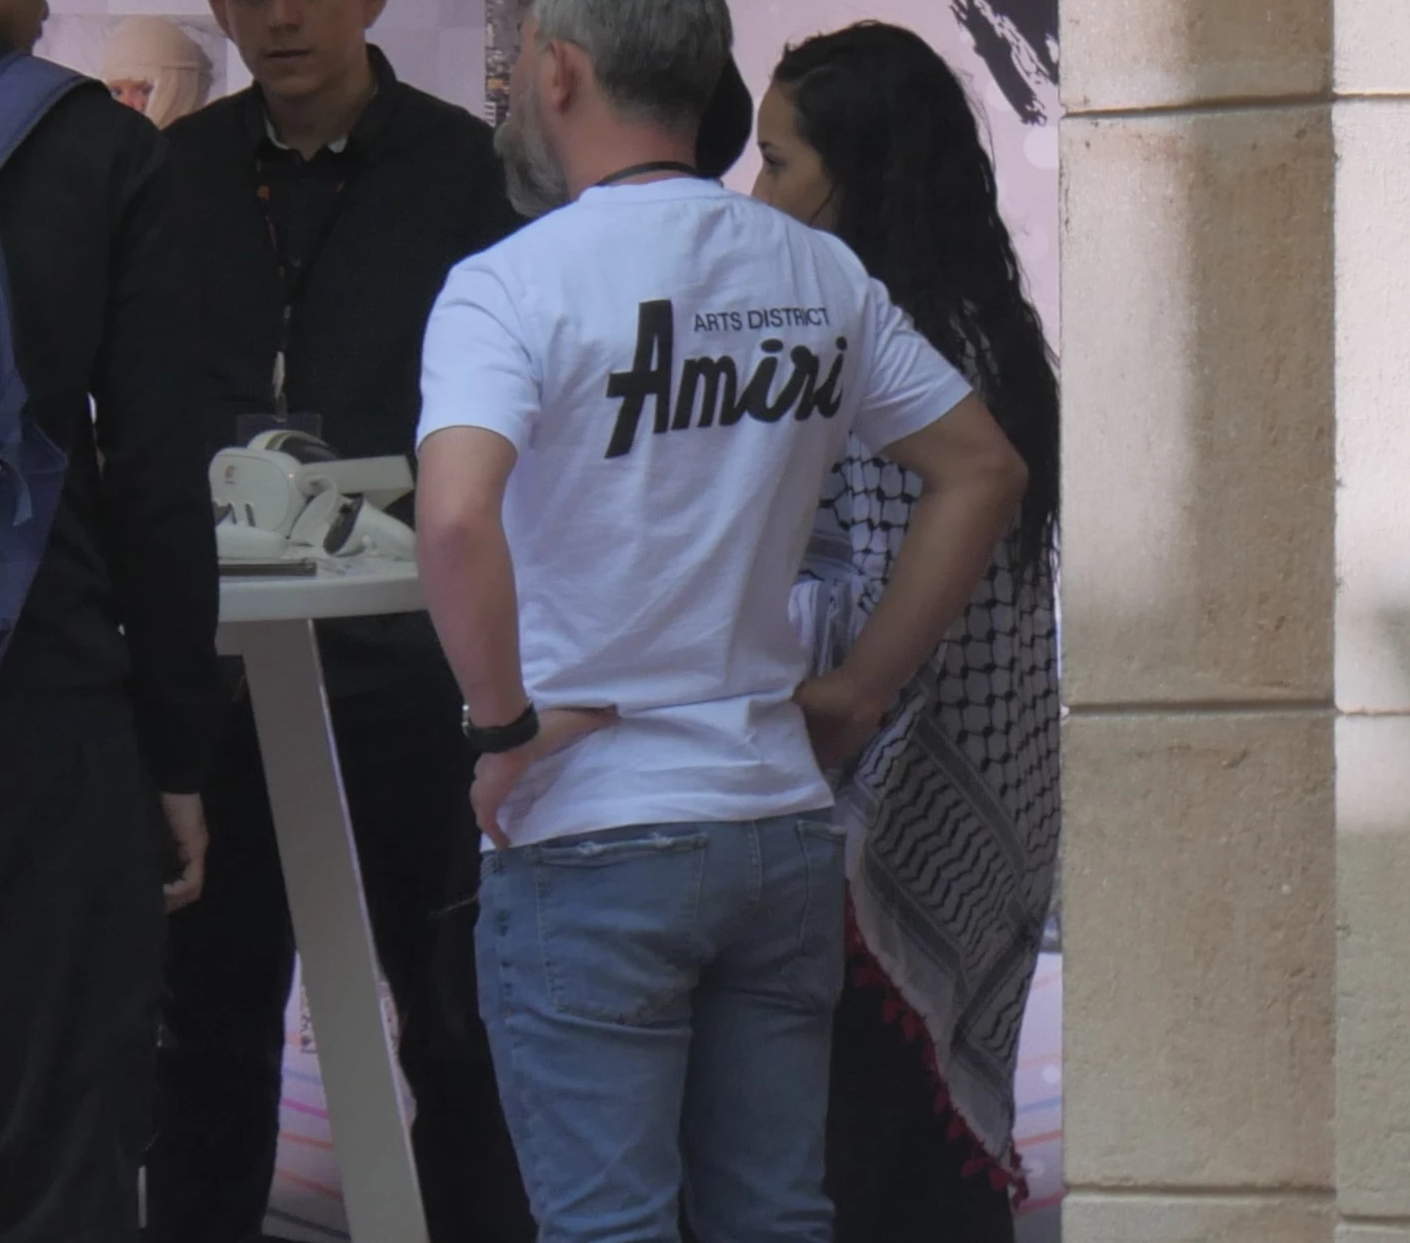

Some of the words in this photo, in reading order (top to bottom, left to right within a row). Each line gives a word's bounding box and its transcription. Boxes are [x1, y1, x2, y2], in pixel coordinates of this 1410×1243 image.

[694, 312, 742, 332] ARTS
[748, 307, 831, 330] DISTRICT
[604, 299, 848, 458] Amiri
